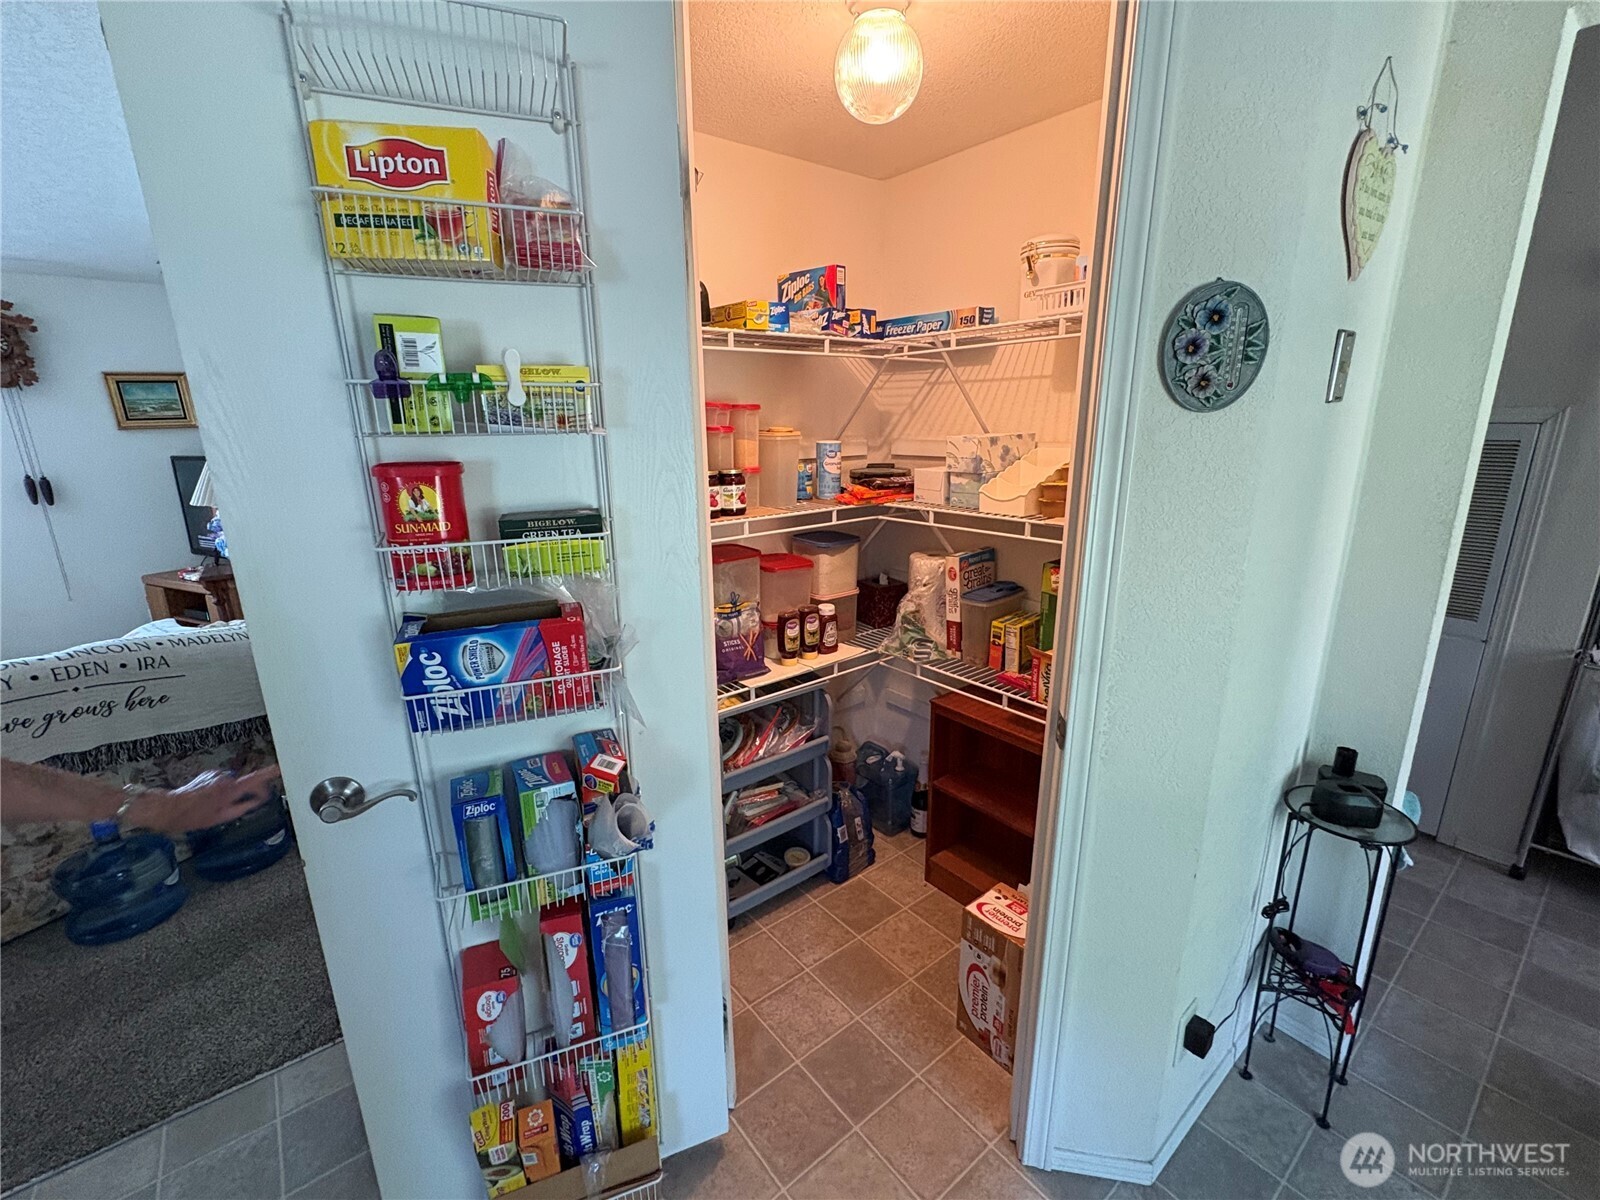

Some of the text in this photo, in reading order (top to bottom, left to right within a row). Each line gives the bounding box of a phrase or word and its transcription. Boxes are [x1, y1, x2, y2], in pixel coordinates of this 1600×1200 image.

[354, 149, 441, 179] Lipton
[781, 273, 811, 303] Ziploc
[885, 324, 916, 336] Freezer
[917, 320, 943, 333] Paper
[959, 315, 975, 326] 150
[520, 368, 561, 376] GELOW
[522, 529, 582, 539] GREEN TEA
[963, 563, 985, 581] great
[964, 573, 992, 591] grains
[53, 640, 152, 662] LINCOLN
[168, 630, 250, 648] MADELYN
[562, 645, 570, 667] SLIDER
[50, 660, 109, 682] EDEN
[137, 655, 171, 672] IRA
[468, 640, 485, 680] POWER SHIELD
[419, 651, 470, 721] Ziploc
[0, 685, 170, 739] ve grows here
[465, 802, 496, 817] Ziploc
[985, 908, 1021, 933] premier
[993, 907, 1024, 928] protein
[500, 967, 511, 978] 75
[971, 975, 982, 1020] premier
[980, 985, 989, 1023] protein
[501, 1102, 510, 1119] 200
[560, 1113, 573, 1142] Wrap
[579, 1120, 592, 1146] Wrap
